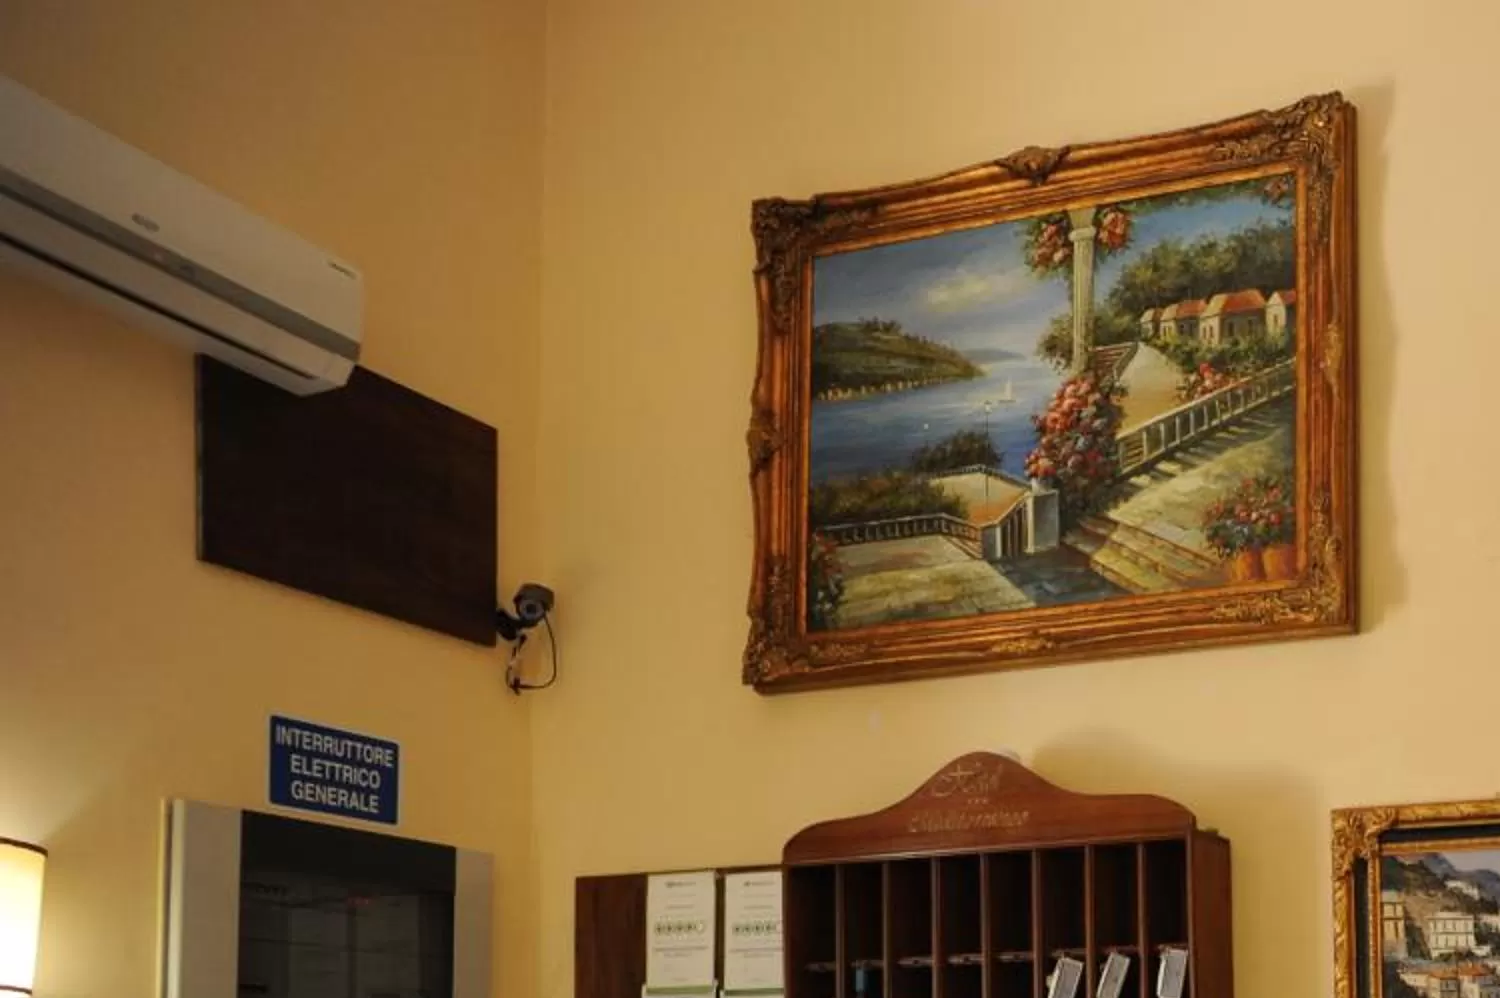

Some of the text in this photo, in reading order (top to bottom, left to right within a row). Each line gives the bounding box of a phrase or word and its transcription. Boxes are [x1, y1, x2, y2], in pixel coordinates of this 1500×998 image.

[275, 723, 394, 768] INTERRUTTORE
[290, 753, 381, 789] ELETTRICO
[291, 779, 380, 814] GENERALE
